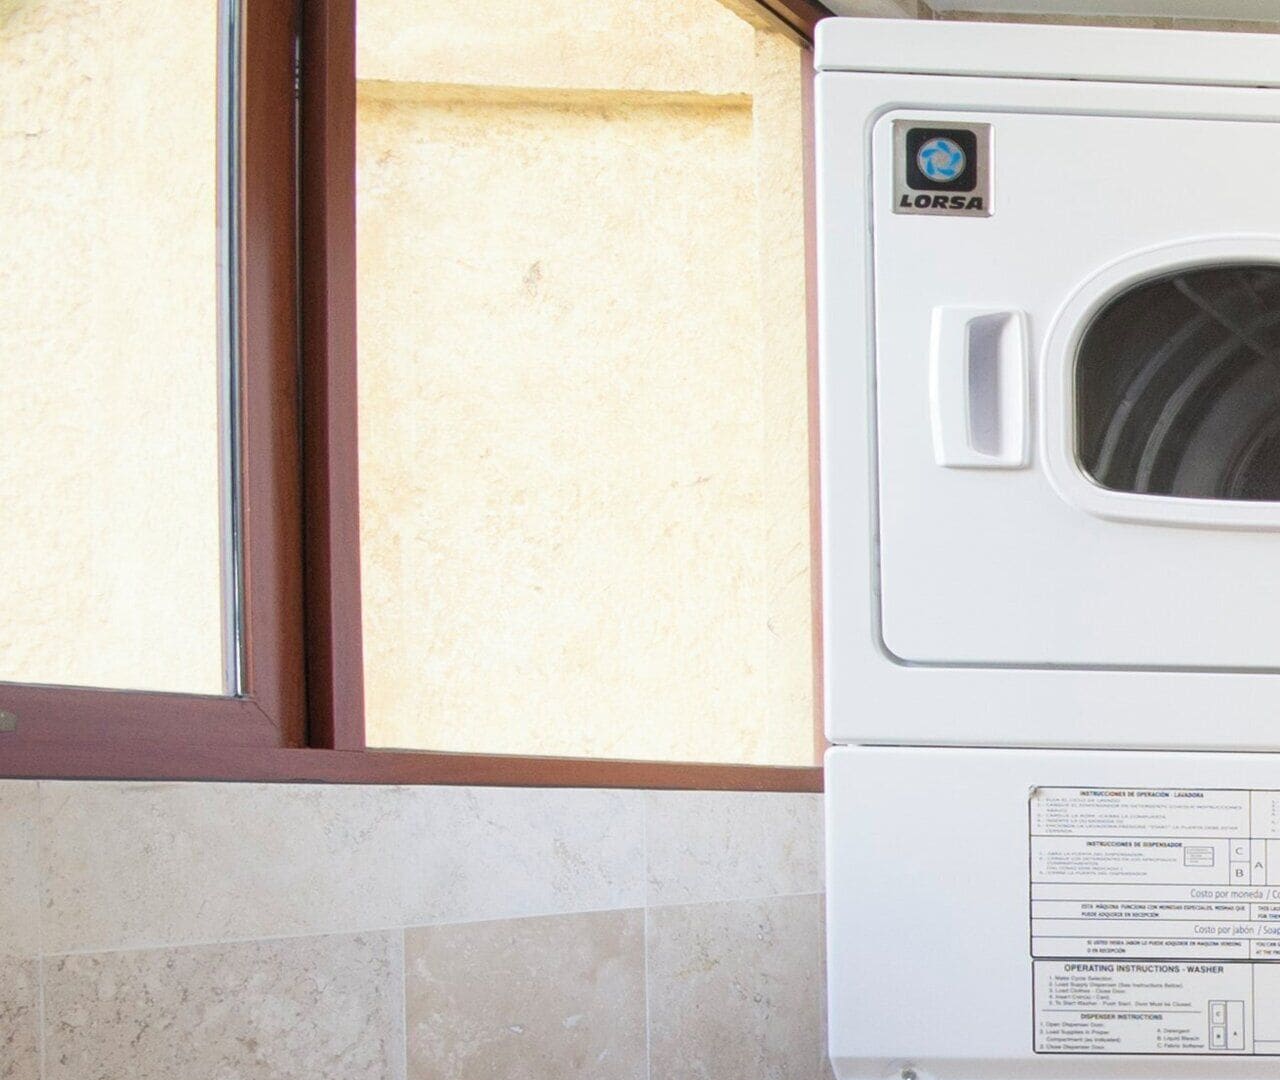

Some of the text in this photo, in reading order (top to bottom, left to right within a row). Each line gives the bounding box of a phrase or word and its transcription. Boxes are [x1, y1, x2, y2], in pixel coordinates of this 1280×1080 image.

[899, 194, 984, 210] LORSA
[1235, 847, 1243, 855] C
[1254, 861, 1264, 869] A
[1235, 869, 1244, 877] B
[1191, 889, 1213, 898] Costo
[1215, 891, 1229, 899] por
[1231, 889, 1263, 899] moneda
[1194, 925, 1216, 934] Costo
[1217, 927, 1231, 935] por
[1232, 924, 1253, 935] jabón
[1064, 964, 1224, 973] OPERATING INSTRUCTIONS WASHER
